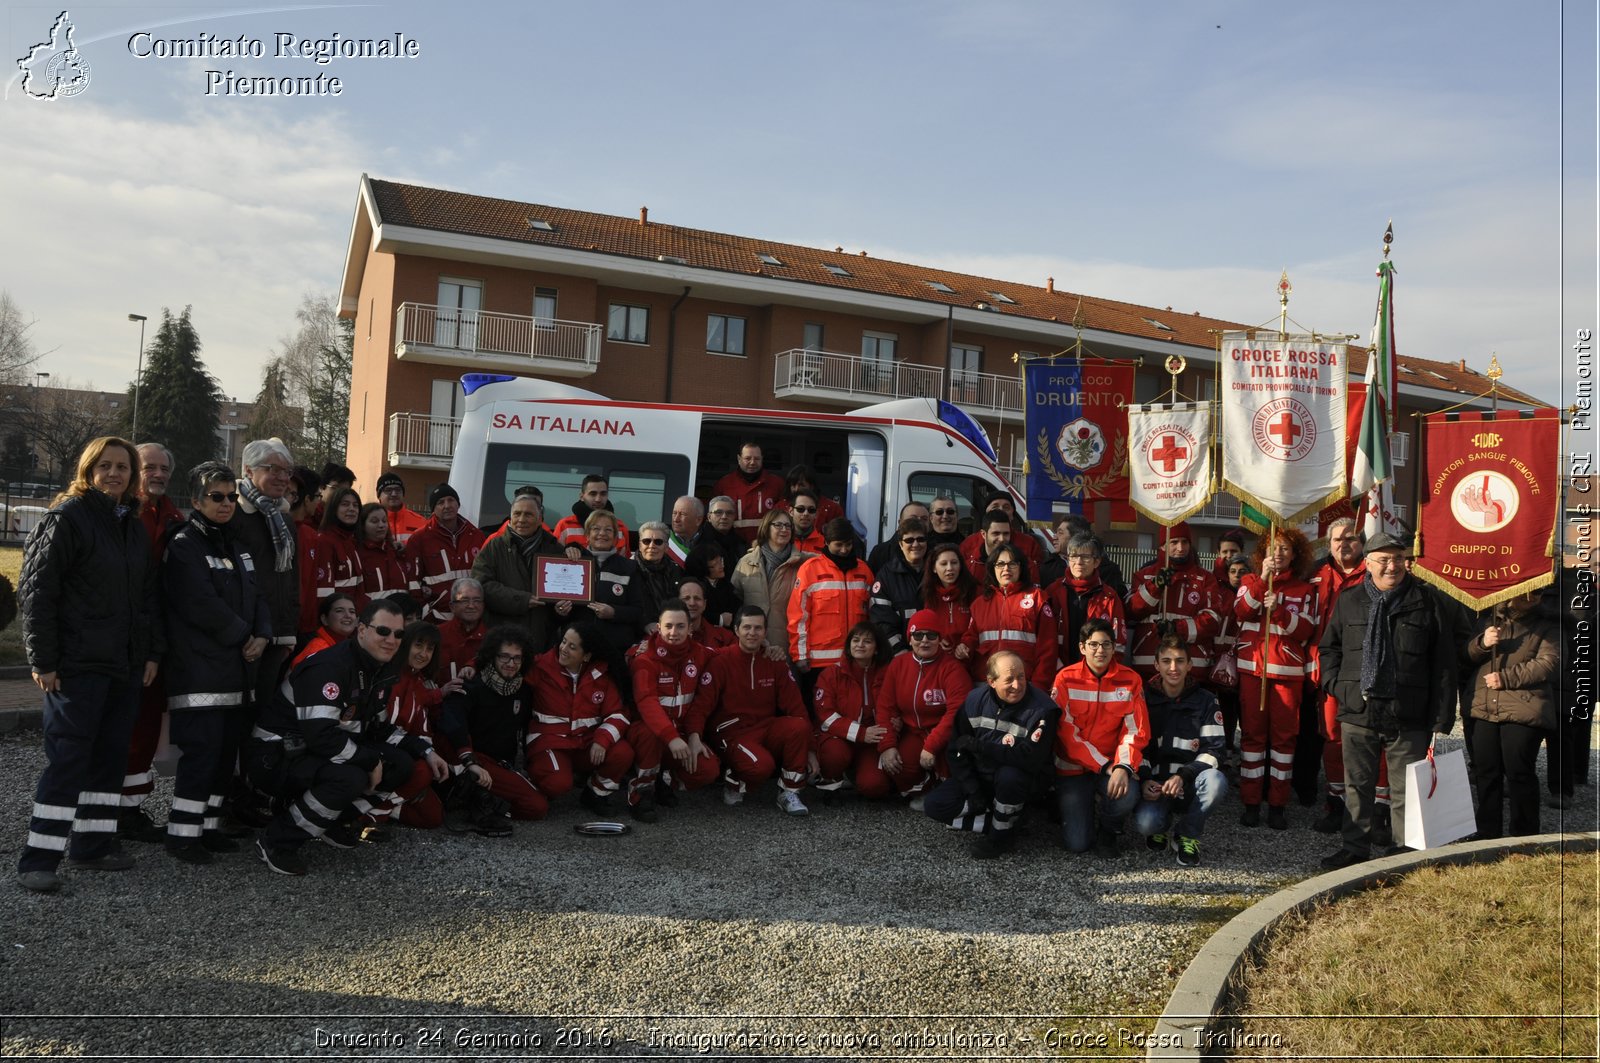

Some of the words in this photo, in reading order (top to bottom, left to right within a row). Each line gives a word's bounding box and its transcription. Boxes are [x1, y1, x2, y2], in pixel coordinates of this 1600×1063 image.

[1231, 348, 1281, 363] CROCE
[1288, 351, 1338, 366] ROSSA
[1251, 365, 1319, 380] ITALIANA
[1049, 376, 1074, 386] PRO
[1080, 376, 1113, 386] LOCO
[1232, 382, 1264, 392] COMITATO
[1266, 383, 1305, 394] PROVINCIALE
[1315, 386, 1337, 396] TORINO
[1035, 391, 1125, 406] DRUENTO
[1273, 400, 1302, 412] GINEVRA
[1263, 405, 1274, 415] DI
[492, 413, 522, 429] SA
[530, 415, 636, 436] ITALIANA
[1305, 419, 1314, 445] AGOSTO
[1141, 434, 1154, 453] CROCE
[1152, 424, 1171, 436] ROSSA
[1172, 424, 1198, 447] ITALIANA
[1255, 412, 1275, 454] CONVENZIONE
[1433, 457, 1465, 496] DONATORI
[1468, 451, 1507, 462] SANGUE
[1508, 457, 1541, 496] PIEMONTE
[1143, 481, 1174, 490] COMITATO
[1175, 480, 1198, 489] LOCALE
[1156, 491, 1187, 500] DRUENTO
[1304, 498, 1352, 525] DRUENTO
[1450, 544, 1496, 554] GRUPPO
[1501, 545, 1513, 555] DI
[1441, 562, 1521, 580] DRUENTO
